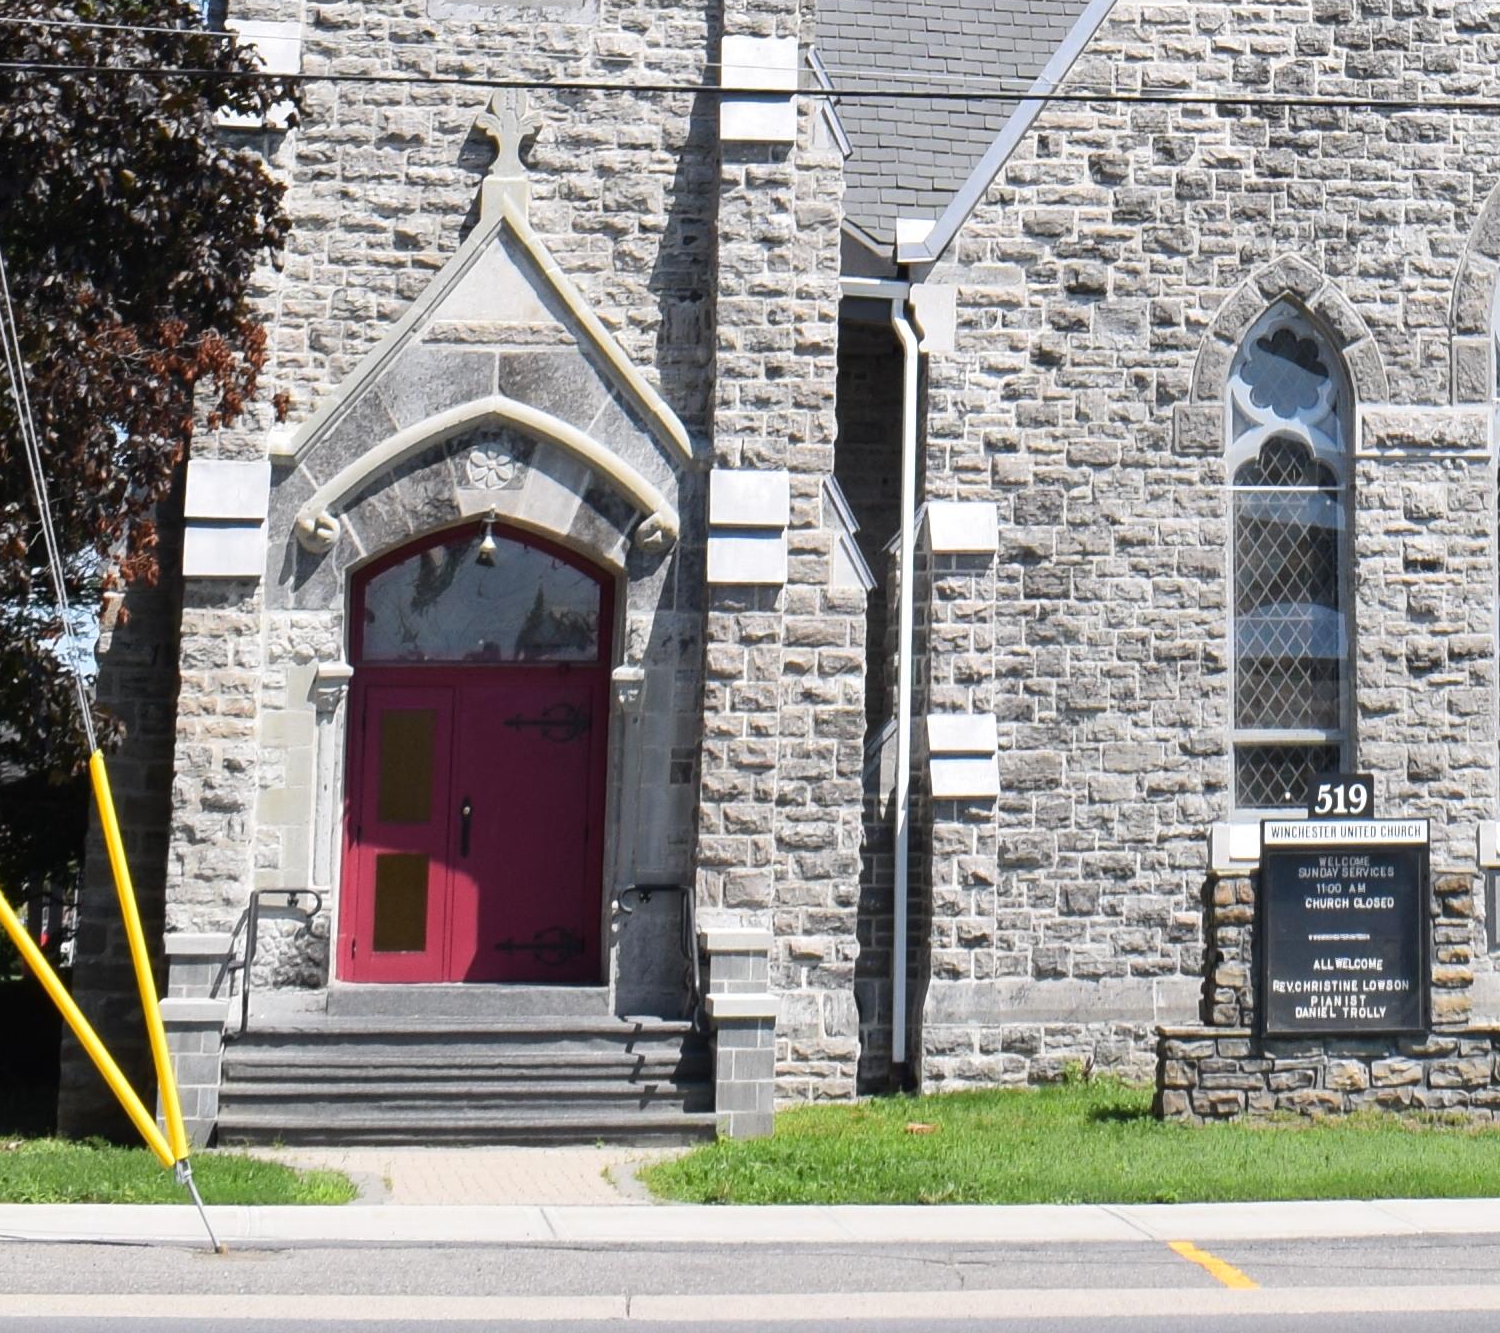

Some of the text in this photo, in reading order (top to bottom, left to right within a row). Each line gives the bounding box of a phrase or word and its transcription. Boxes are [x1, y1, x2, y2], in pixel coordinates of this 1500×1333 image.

[1314, 783, 1368, 814] 519
[1271, 825, 1421, 839] WINCHESTER UNITED CHURCH
[1318, 856, 1370, 867] WELCOME
[1298, 867, 1395, 879] SUNDAY SERVICES
[1348, 882, 1367, 894] AM
[1305, 896, 1395, 909] CHURCH CLOSED
[1313, 957, 1383, 970] ALL WELCOME
[1363, 979, 1409, 991] LOWSON
[1310, 995, 1367, 1007] PIANIST
[1295, 1006, 1387, 1019] DANIEL TROLLY
